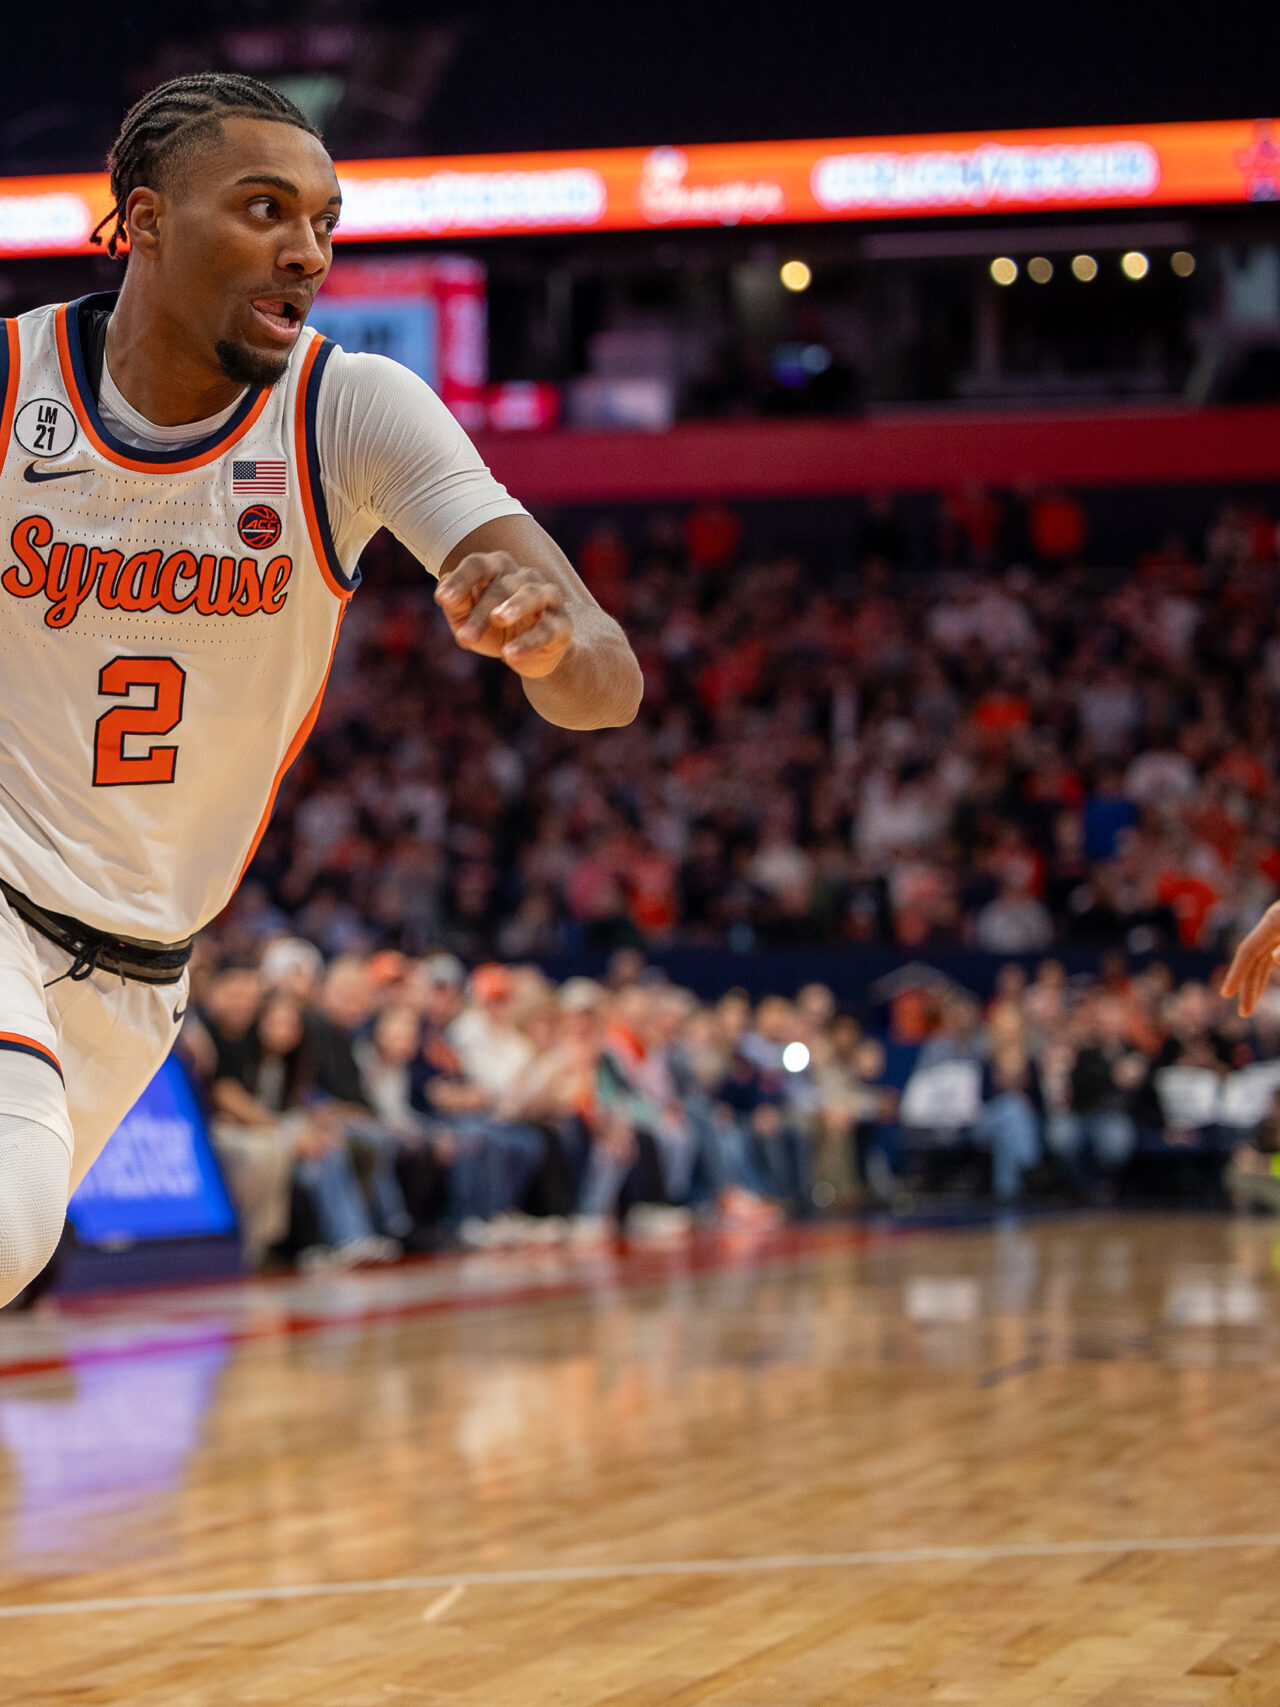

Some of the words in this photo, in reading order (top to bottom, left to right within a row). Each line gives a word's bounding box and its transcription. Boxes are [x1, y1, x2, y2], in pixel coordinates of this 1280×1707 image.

[37, 405, 58, 425] LM
[33, 424, 55, 451] 21
[245, 519, 279, 530] ACC
[1, 514, 293, 628] Syracuse
[92, 655, 187, 787] 2
